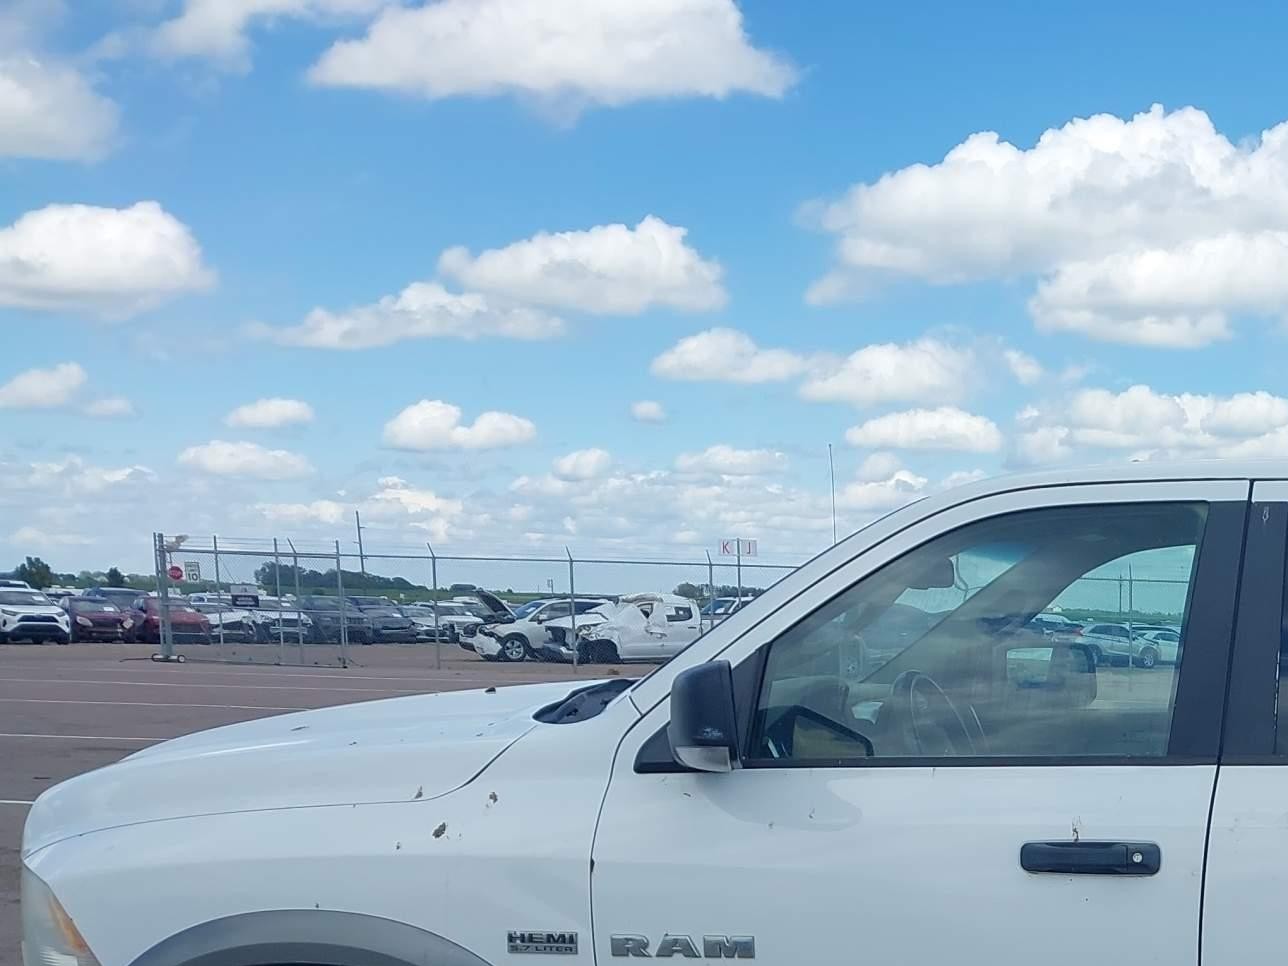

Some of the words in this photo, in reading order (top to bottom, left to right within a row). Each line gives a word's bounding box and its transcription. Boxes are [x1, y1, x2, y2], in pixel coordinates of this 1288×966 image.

[722, 541, 731, 555] K
[187, 572, 198, 581] 10
[507, 930, 576, 945] HEMI
[535, 945, 574, 953] LITER
[610, 933, 756, 958] RAM
